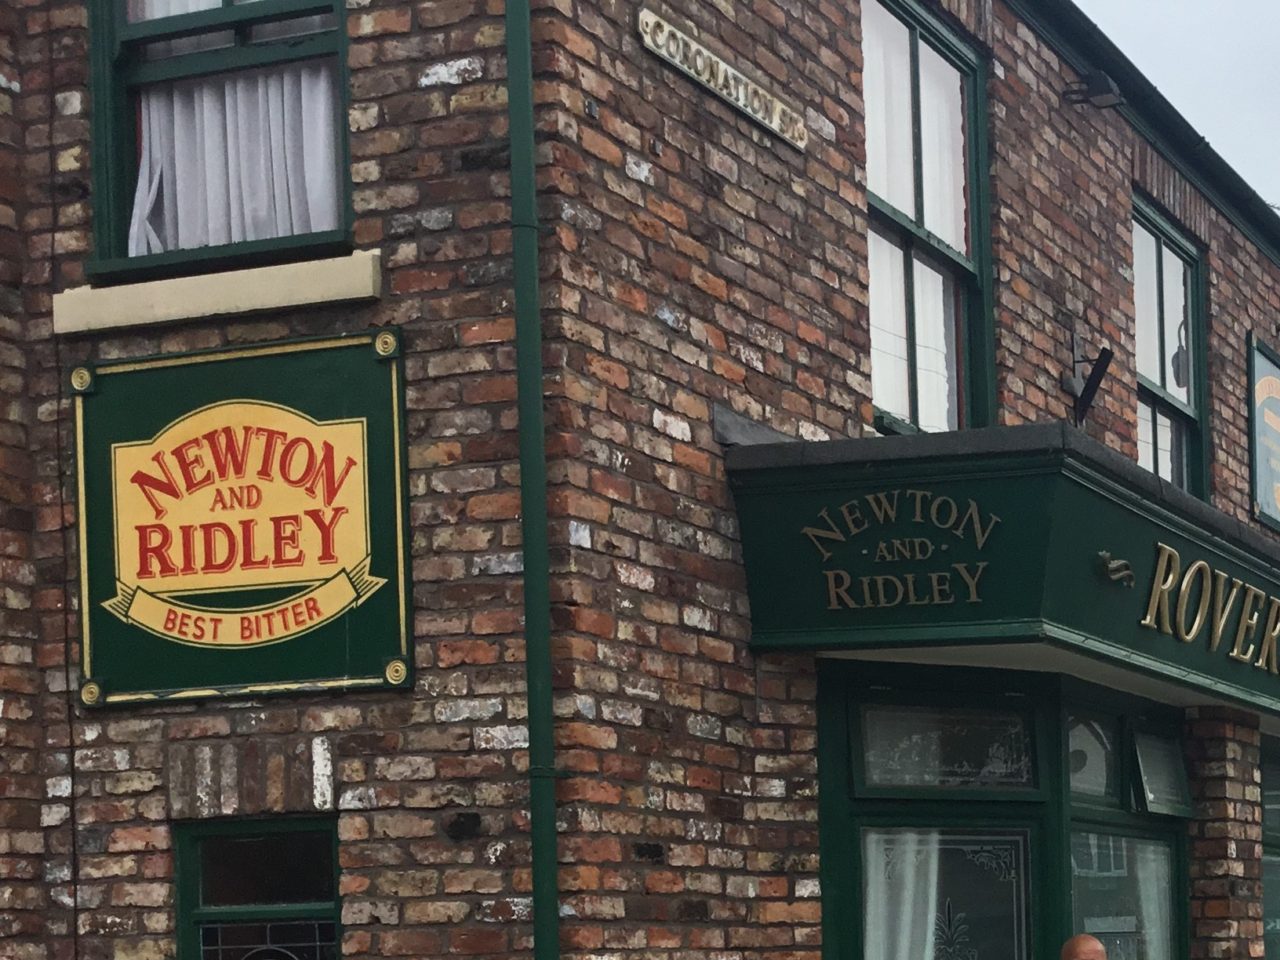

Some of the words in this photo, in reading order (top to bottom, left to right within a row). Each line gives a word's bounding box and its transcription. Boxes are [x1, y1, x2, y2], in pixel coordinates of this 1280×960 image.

[651, 20, 774, 125] CORONATION
[130, 425, 358, 520] NEWTON
[209, 484, 263, 512] AND
[135, 506, 349, 580] RIDLEY
[801, 489, 1002, 562] NEWTON
[874, 538, 933, 562] AND
[822, 562, 989, 610] RIDLEY
[163, 608, 223, 641] BEST
[239, 597, 323, 641] BITTER
